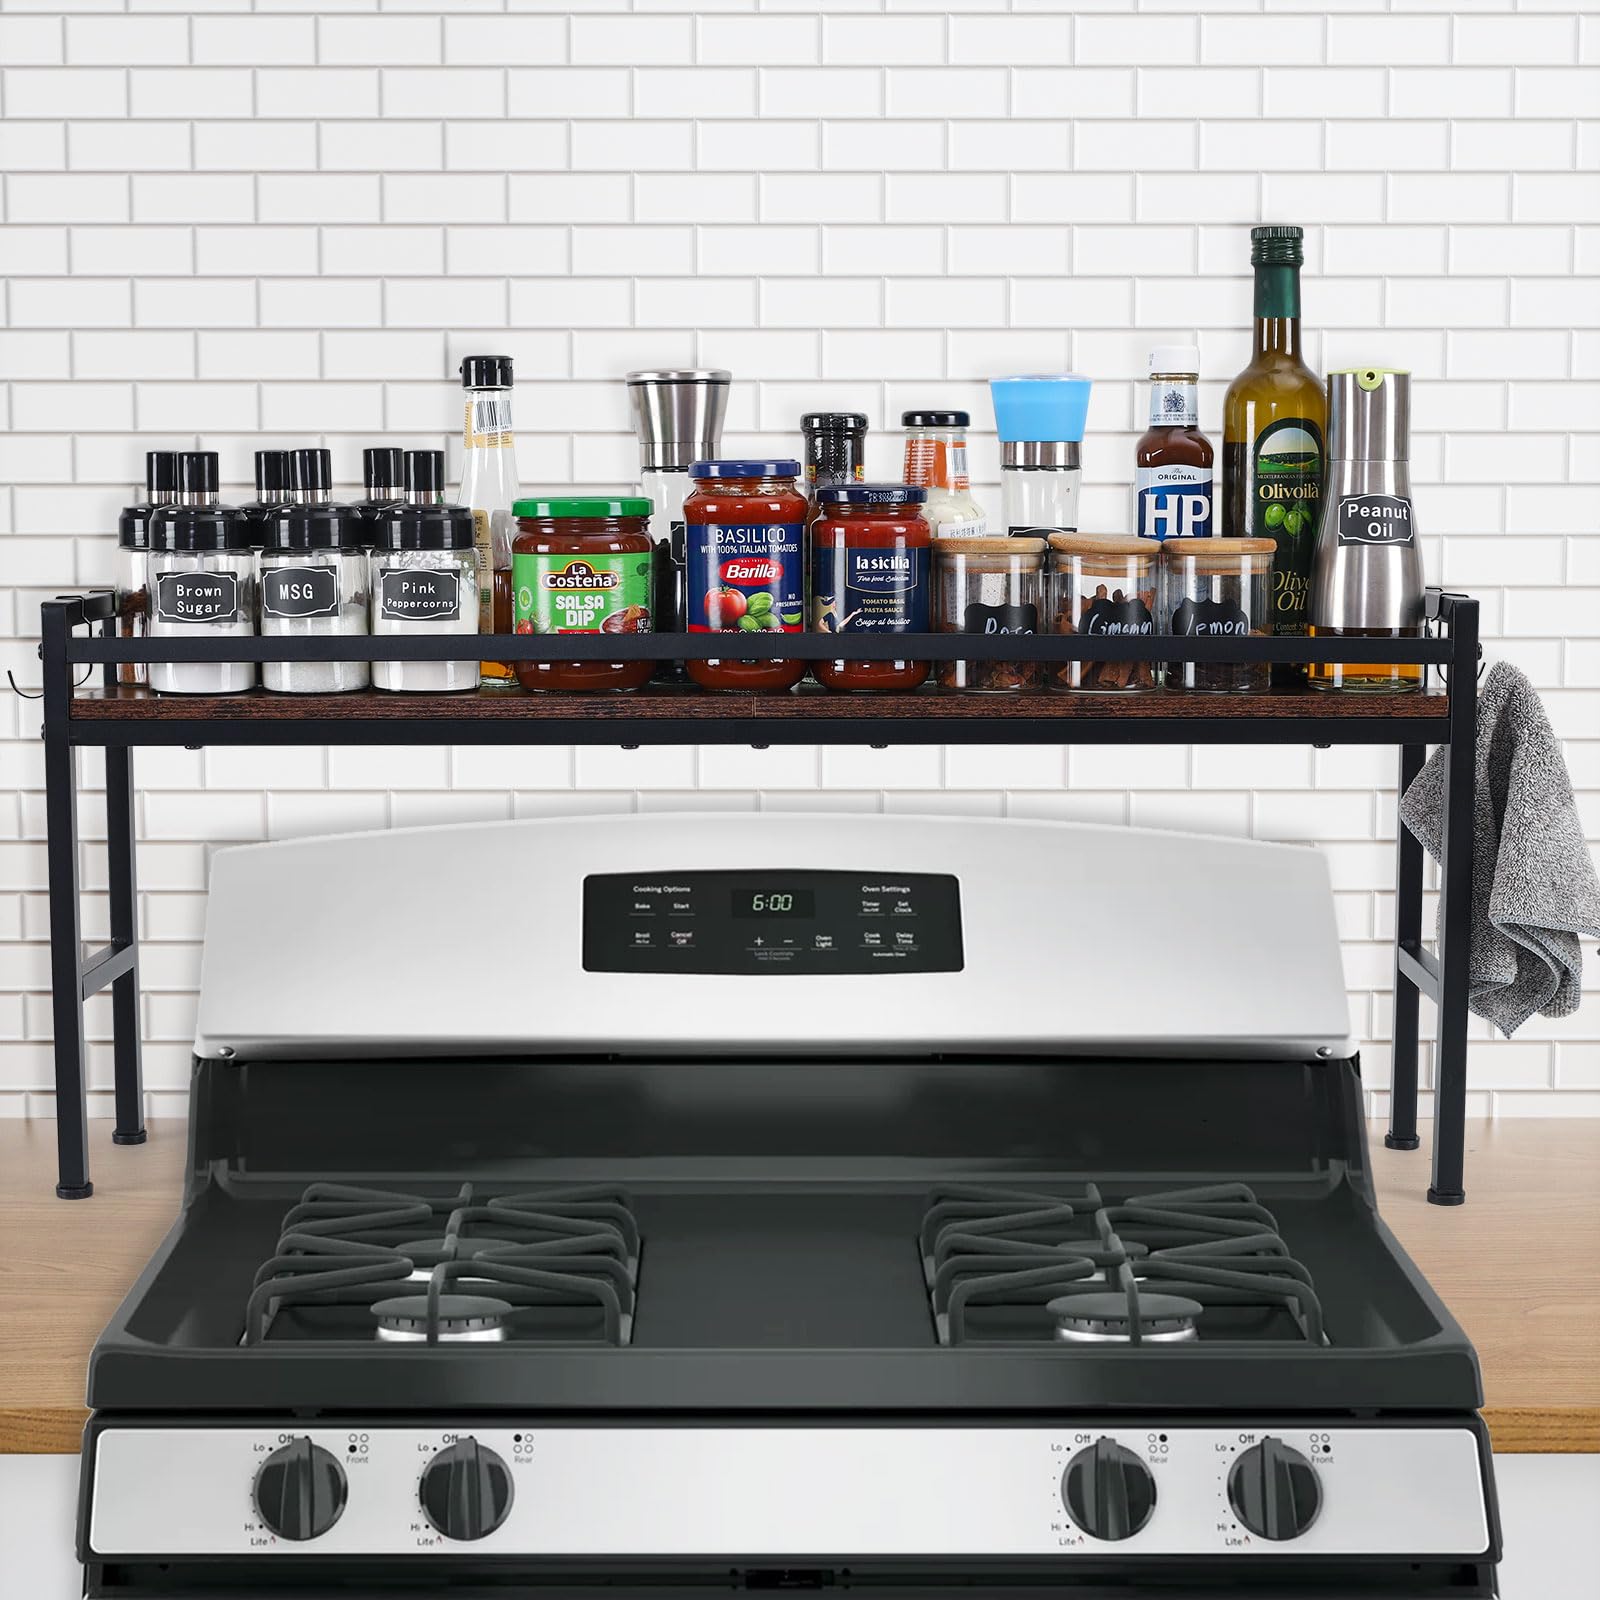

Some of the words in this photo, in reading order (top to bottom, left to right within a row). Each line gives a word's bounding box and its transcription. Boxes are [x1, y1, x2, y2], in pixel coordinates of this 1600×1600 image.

[1258, 483, 1319, 499] Olivoilà
[1143, 494, 1210, 537] HP
[1347, 503, 1408, 521] Peanut
[1367, 522, 1393, 537] Oil
[715, 527, 786, 544] BASILICO
[700, 545, 717, 554] WITH
[718, 545, 738, 554] 100%
[739, 545, 767, 554] ITALIAN
[768, 543, 798, 553] TOMATOES
[855, 555, 869, 570] la
[870, 555, 910, 570] sicilia
[571, 564, 587, 575] La
[725, 563, 777, 579] Barilla
[546, 574, 613, 588] Costeña
[176, 584, 222, 597] Brown
[279, 583, 314, 600] MSG
[401, 582, 436, 594] Pink
[787, 592, 796, 600] NO
[1277, 591, 1307, 611] Oil
[176, 600, 221, 615] Sugar
[387, 597, 454, 609] Peppercorns
[555, 595, 605, 610] SALSA
[566, 610, 595, 626] DIP
[632, 885, 662, 893] Cooking
[663, 885, 691, 893] Options
[862, 885, 881, 893] Oven
[881, 885, 911, 894] Settings
[752, 894, 793, 911] 6:00
[278, 1433, 294, 1444] Off
[442, 1433, 458, 1444] Off
[1074, 1433, 1091, 1444] Off
[1238, 1433, 1255, 1444] Off
[253, 1443, 265, 1452] Lo
[417, 1443, 429, 1452] Lo
[1051, 1443, 1063, 1452] Lo
[1215, 1443, 1227, 1452] Lo
[346, 1455, 369, 1464] Front
[514, 1456, 533, 1464] Rear
[1149, 1456, 1168, 1464] Rear
[1311, 1455, 1334, 1464] Front
[244, 1523, 254, 1531] Hi
[410, 1523, 421, 1531] Hi
[1051, 1523, 1061, 1531] Hi
[1217, 1523, 1227, 1531] Hi
[250, 1537, 268, 1546] Lite
[417, 1537, 435, 1546] Lite
[1059, 1537, 1076, 1546] Lite
[1225, 1537, 1243, 1546] Lite
